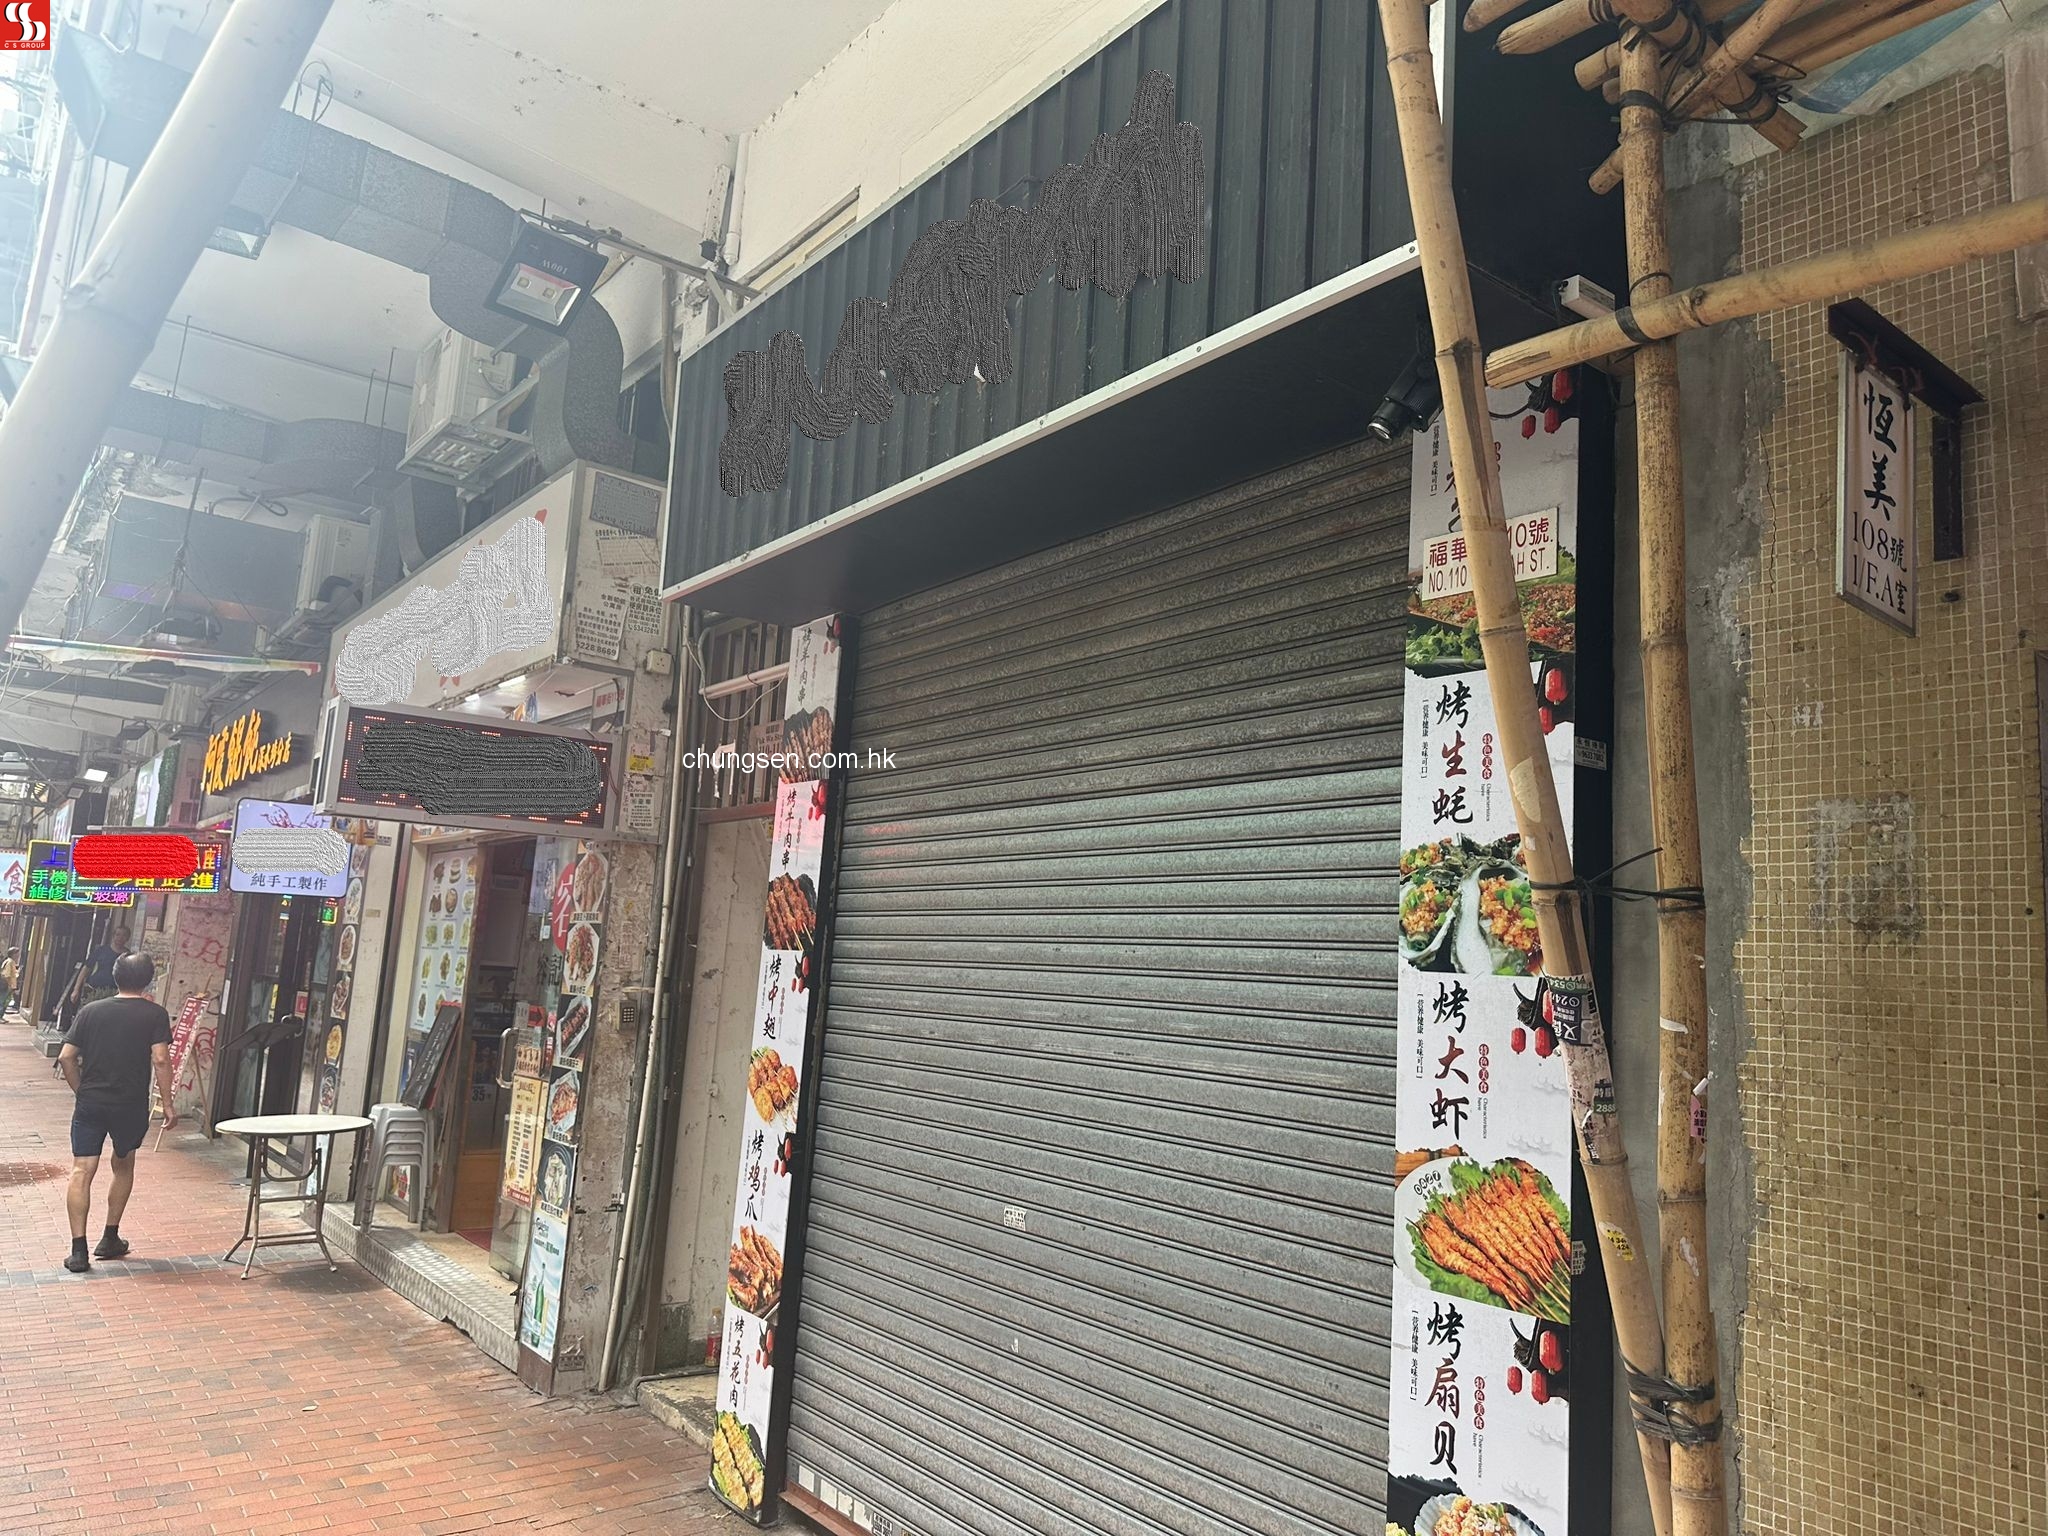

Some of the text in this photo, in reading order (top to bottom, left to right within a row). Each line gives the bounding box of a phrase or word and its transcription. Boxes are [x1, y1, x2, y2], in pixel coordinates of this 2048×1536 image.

[1853, 511, 1907, 573] 108號
[1432, 680, 1474, 825] 烤生蚝
[781, 788, 798, 872] 烤羊肉串
[29, 884, 66, 900] 維修
[32, 869, 68, 884] 手機
[250, 873, 328, 890] 純手工製作
[763, 954, 782, 1040] 烤中翅
[1429, 980, 1470, 1140] 烤大虾
[744, 1129, 766, 1222] 烤鸡爪
[727, 1315, 745, 1408] 烤五花肉
[1424, 1301, 1465, 1476] 烤扇贝
